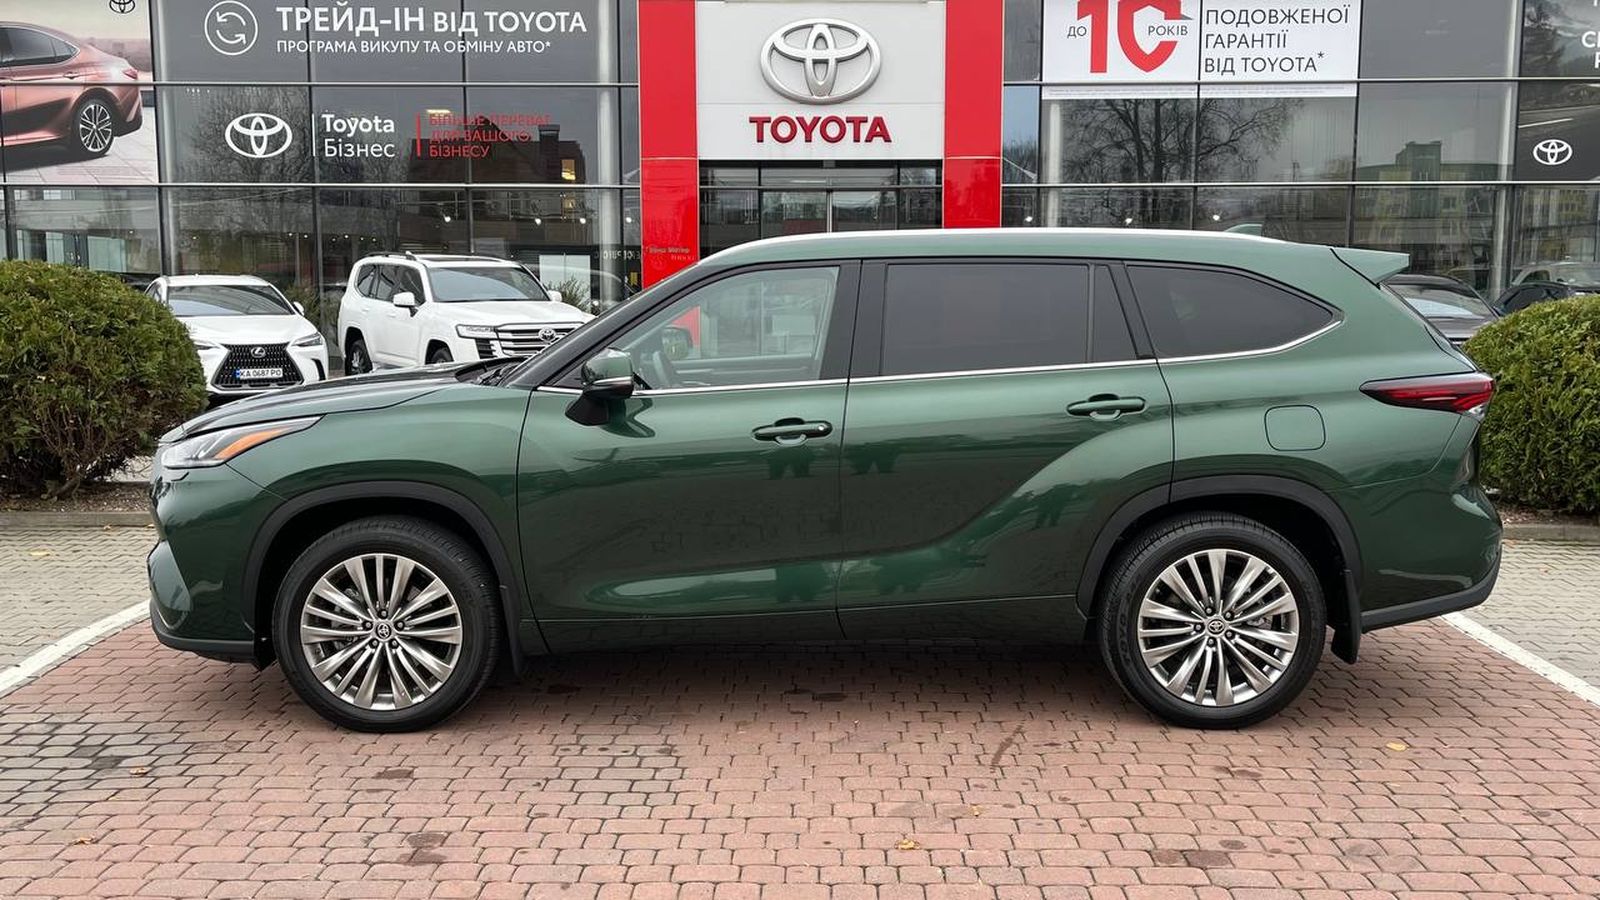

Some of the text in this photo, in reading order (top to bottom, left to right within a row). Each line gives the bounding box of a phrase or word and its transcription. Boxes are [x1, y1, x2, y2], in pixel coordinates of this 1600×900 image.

[276, 0, 587, 37] ТРЕЙД-ІН ВІД TOYOTA
[1206, 4, 1351, 28] ПОДОВЖЕНОЇ
[1067, 25, 1087, 39] ДО
[1148, 25, 1188, 36] РОКІВ
[1205, 29, 1289, 49] ГАРАНТІЇ
[277, 40, 357, 53] ПРОГРАМА
[361, 40, 419, 53] ВИКУПУ
[423, 40, 440, 53] ТА
[444, 40, 502, 53] ОБМІНУ
[1204, 57, 1236, 76] ВІД
[321, 114, 395, 137] Toyota
[749, 115, 892, 144] TOYOTA
[324, 138, 395, 157] Бізнес
[429, 145, 490, 157] БІЗНЕСУ
